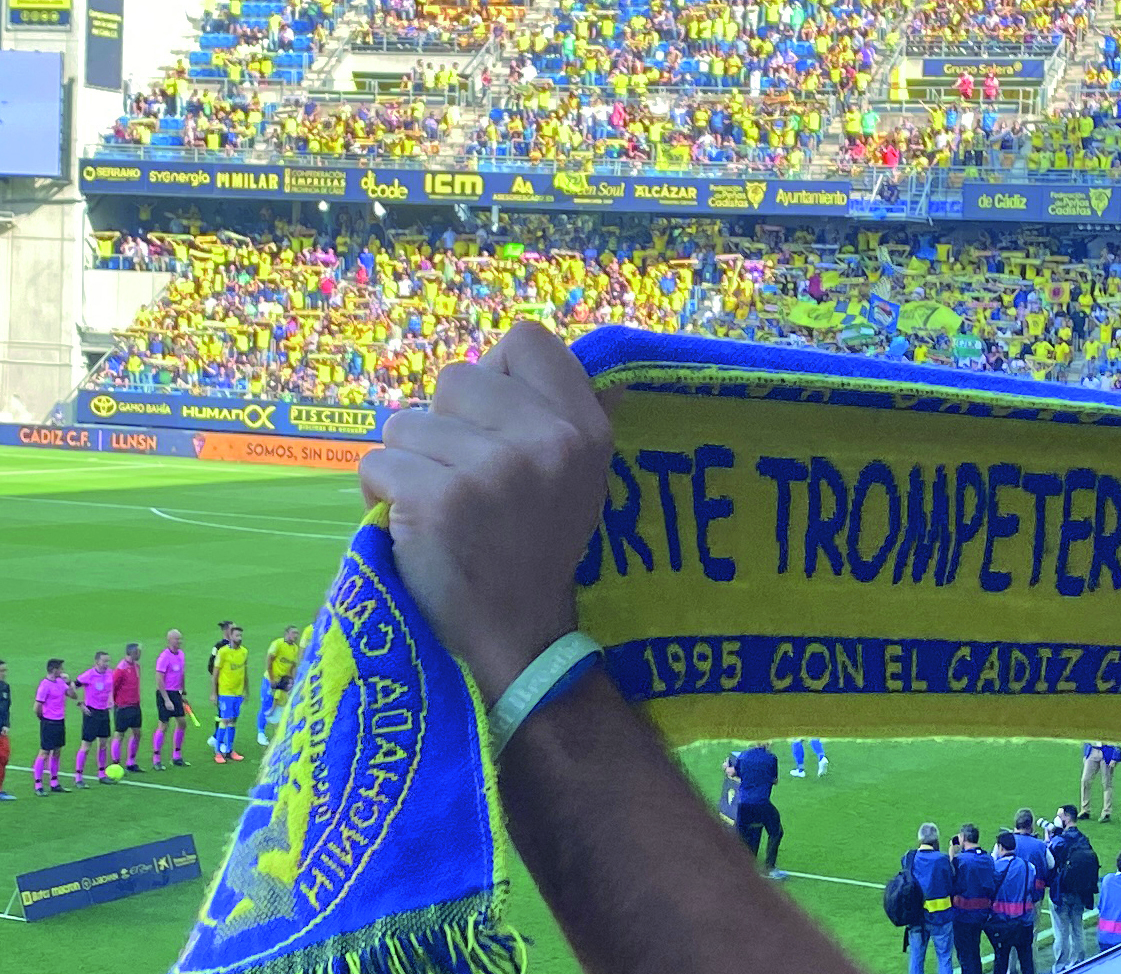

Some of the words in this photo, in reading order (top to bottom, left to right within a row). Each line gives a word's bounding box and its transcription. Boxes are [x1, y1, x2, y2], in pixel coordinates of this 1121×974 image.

[96, 167, 141, 178] SERRANO
[232, 172, 279, 190] MILAR
[424, 173, 484, 195] ICM
[598, 182, 625, 197] Soul
[635, 183, 698, 199] ALCÁZAR
[776, 188, 847, 207] Ayuntamiento
[978, 193, 993, 208] de
[994, 193, 1027, 209] Cádiz
[146, 402, 172, 415] BAHÍA
[291, 407, 375, 426] PISCINIA
[19, 425, 63, 445] CÁDIZ
[66, 431, 91, 447] C.F.
[247, 442, 298, 461] SOMOS,
[302, 446, 322, 461] SIN
[643, 640, 743, 692] 1995
[769, 641, 865, 692] CON
[884, 644, 928, 692] EL
[947, 646, 1084, 693] CADIZ
